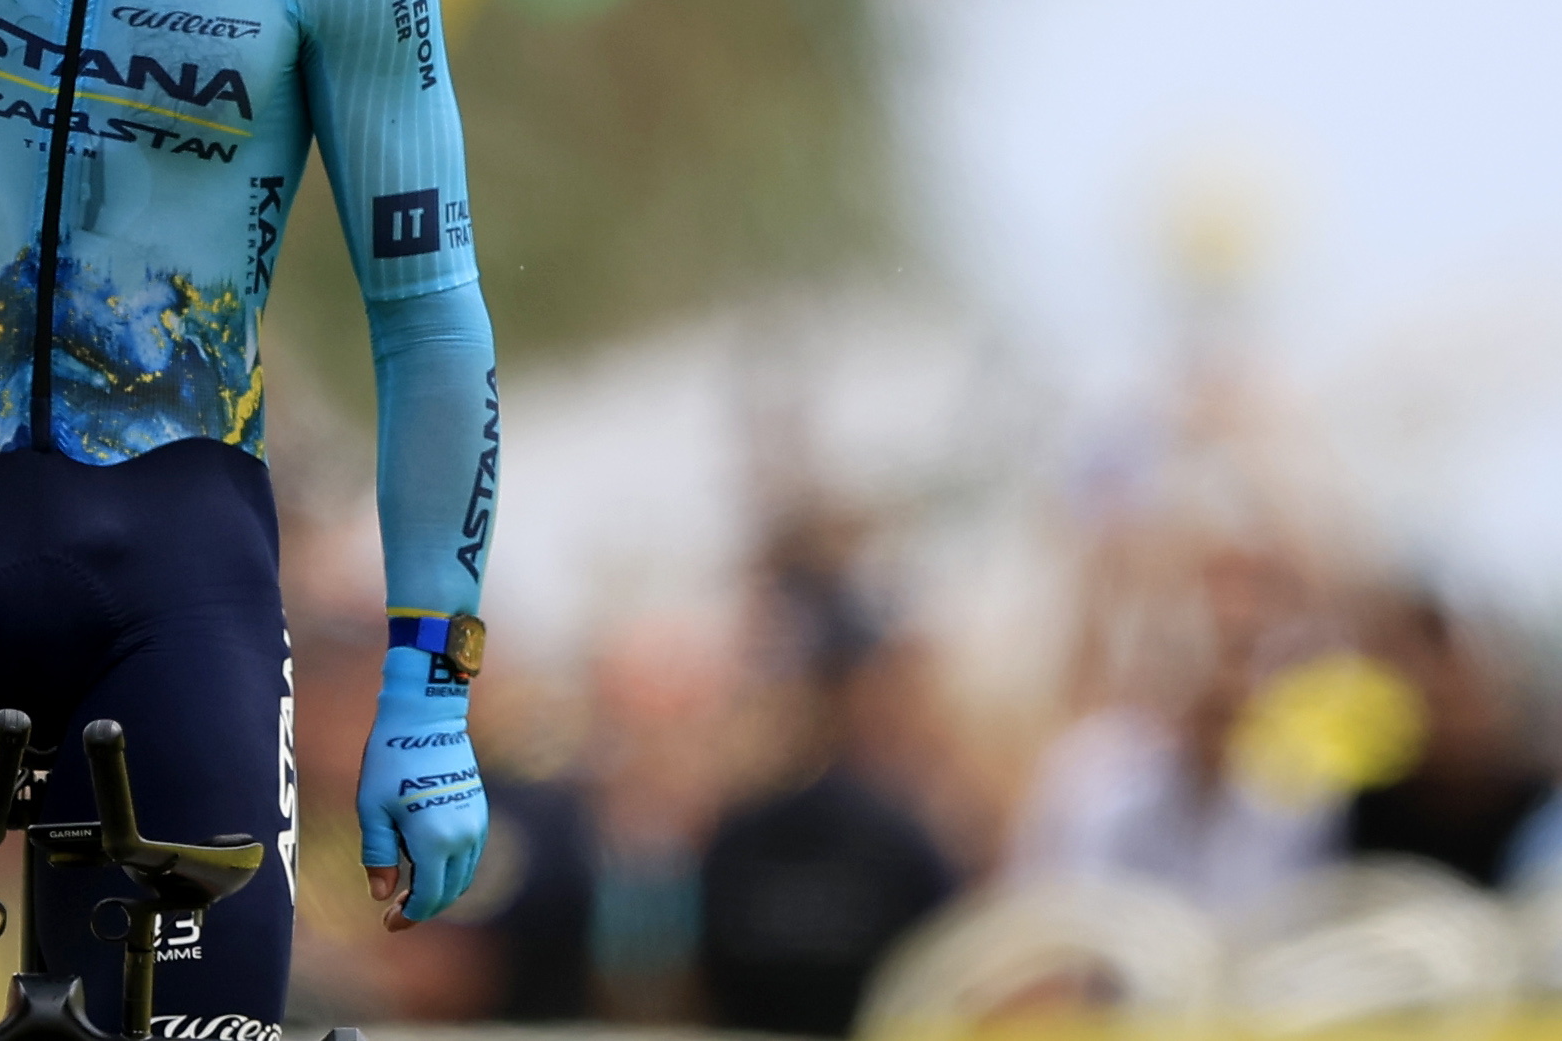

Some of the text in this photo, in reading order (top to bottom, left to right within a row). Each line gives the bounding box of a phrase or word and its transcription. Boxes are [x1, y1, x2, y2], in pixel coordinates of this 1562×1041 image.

[111, 6, 261, 39] Wilier
[253, 176, 285, 294] KAZ
[392, 206, 425, 242] IT
[49, 829, 93, 839] GARMIN
